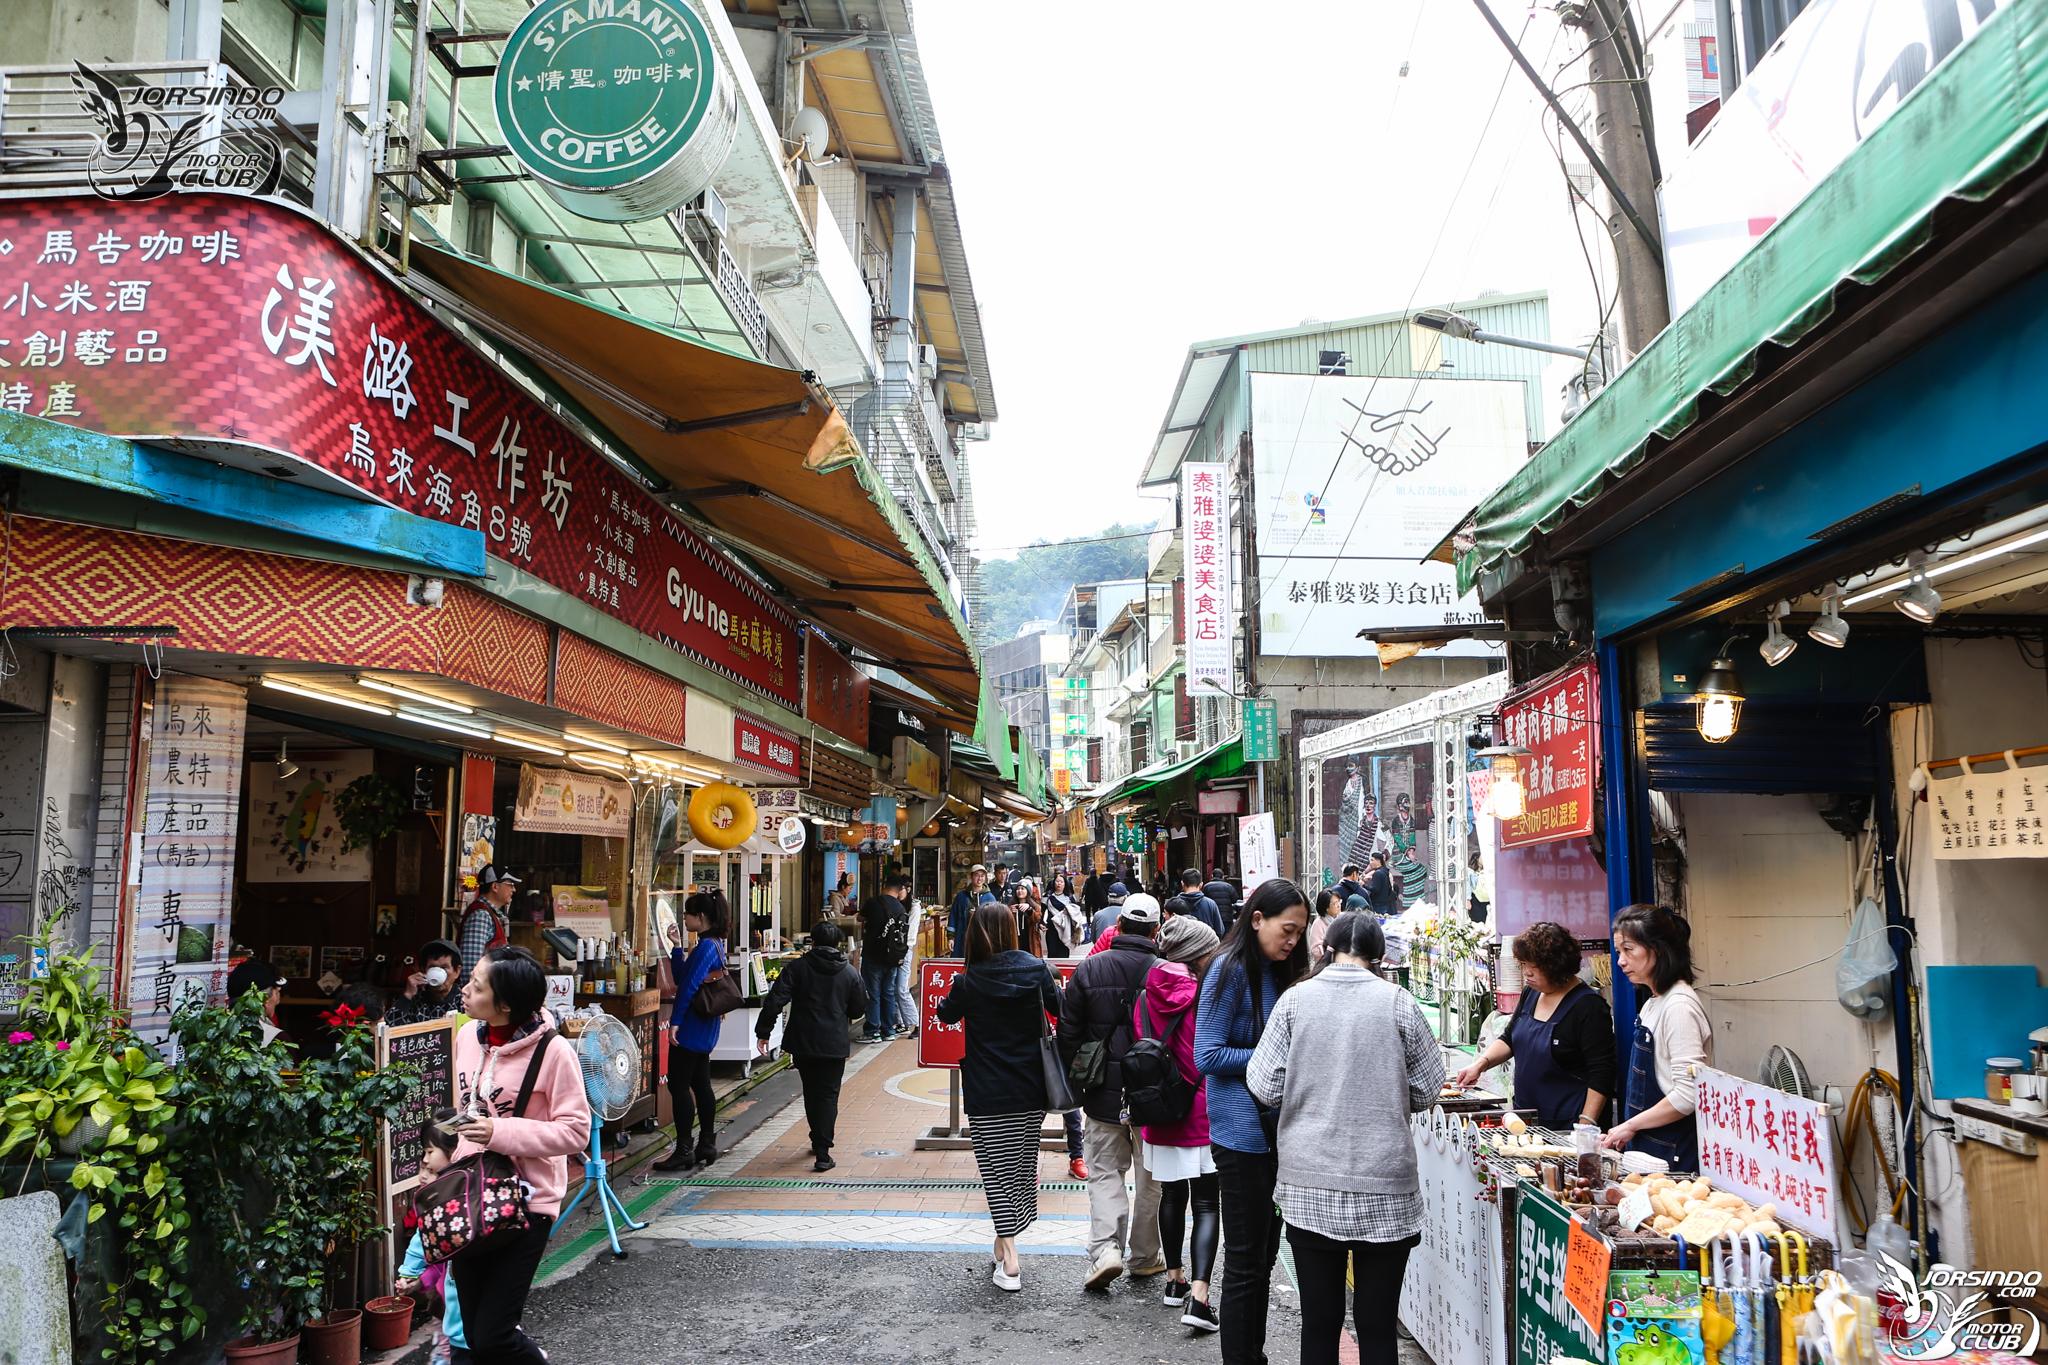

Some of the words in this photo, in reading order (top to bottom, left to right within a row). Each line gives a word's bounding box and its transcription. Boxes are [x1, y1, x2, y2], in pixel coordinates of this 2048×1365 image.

[614, 63, 674, 85] 咖啡
[540, 116, 667, 164] COFFEE
[37, 229, 241, 265] 馬告咖啡
[3, 279, 152, 317] 小米酒
[344, 421, 532, 562] 烏來海角8號
[610, 490, 651, 536] 馬告咖啡
[602, 517, 635, 555] 小米酒
[594, 544, 638, 588] 文創藝品
[1193, 471, 1217, 640] 泰雅婆婆美食店
[1287, 580, 1452, 605] 泰雅婆婆美食店
[163, 698, 214, 738] 烏來
[1504, 688, 1569, 749] 黑豬肉香腸
[1570, 681, 1585, 705] 一支
[1570, 709, 1586, 732] 35元
[162, 746, 212, 787] 農特
[1572, 739, 1586, 763] 一支
[1572, 767, 1587, 790] 35元
[158, 798, 208, 835] 產品
[763, 815, 783, 831] 35
